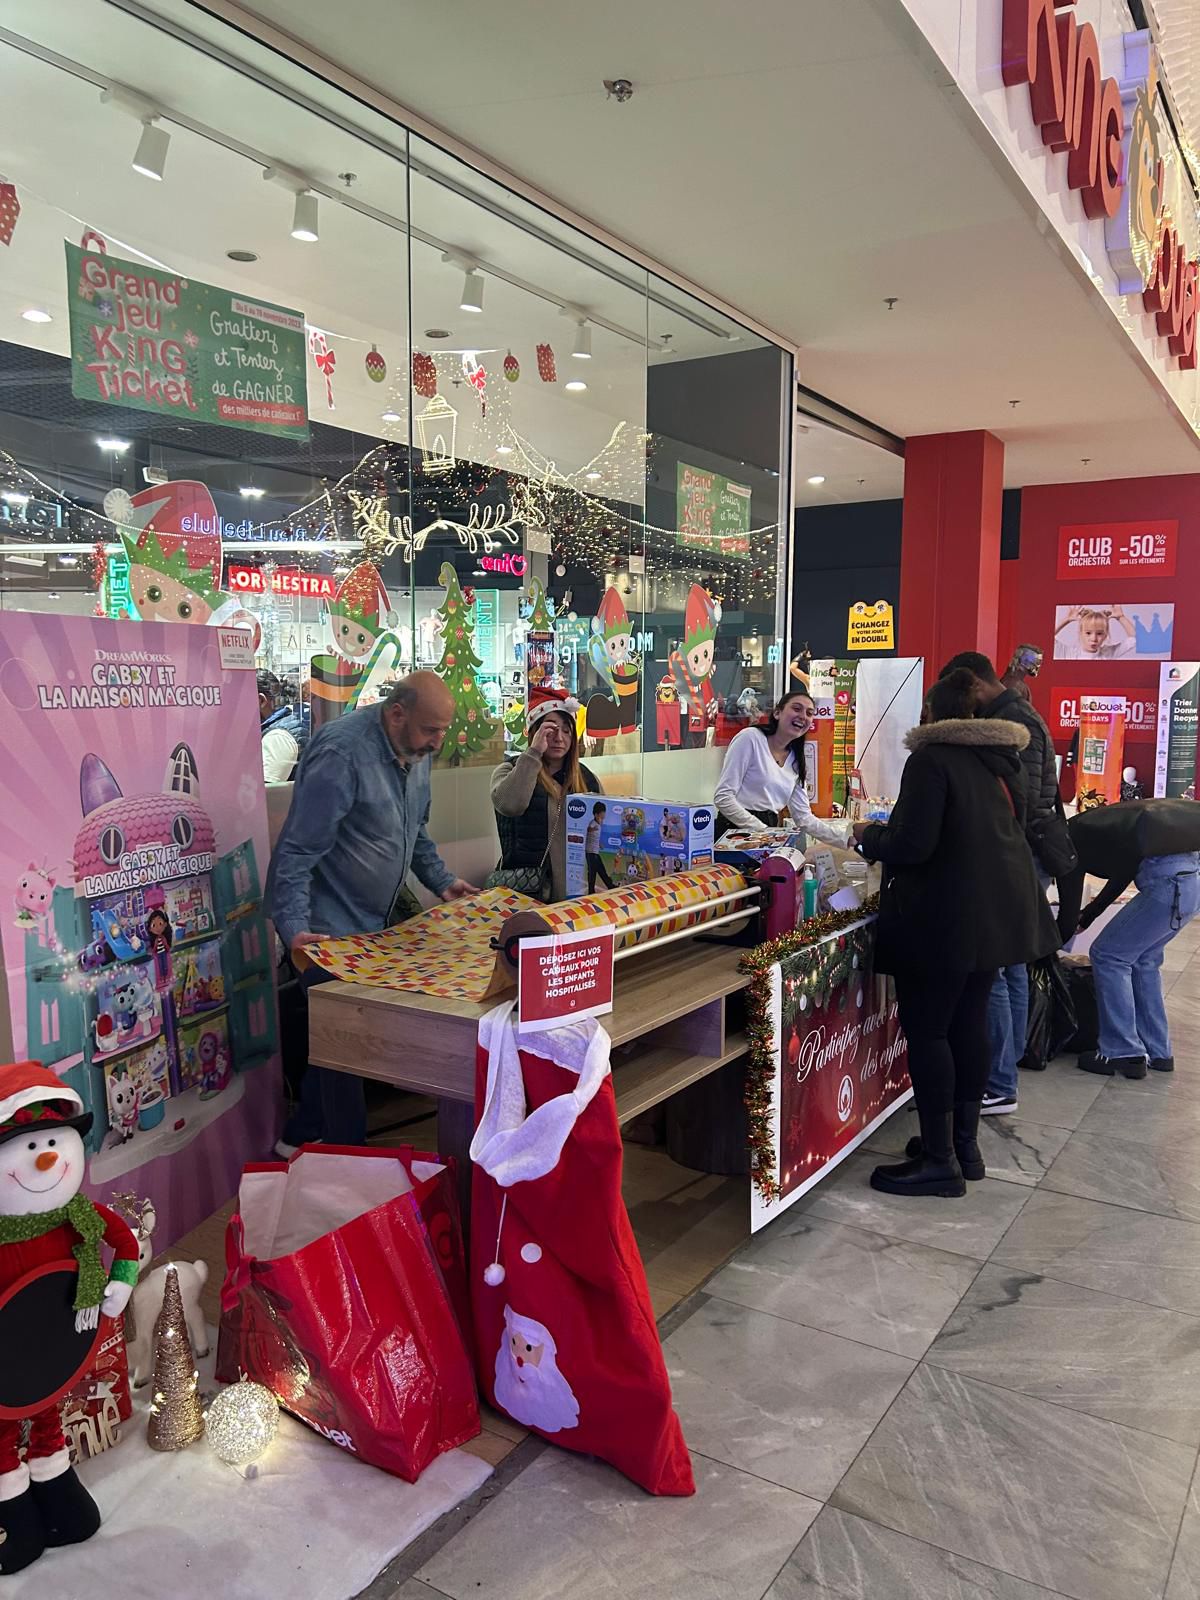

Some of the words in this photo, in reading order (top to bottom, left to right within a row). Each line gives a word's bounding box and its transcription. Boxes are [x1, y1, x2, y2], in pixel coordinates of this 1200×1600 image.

[81, 256, 181, 306] Grand
[114, 294, 162, 334] jeu
[214, 348, 231, 366] et
[84, 363, 198, 412] Ticket
[212, 380, 230, 397] de
[233, 380, 295, 404] GAGNER
[1068, 537, 1112, 557] CLUB
[1068, 556, 1111, 567] ORCHESTRA
[221, 634, 250, 650] NETFLIX
[861, 635, 888, 643] DOUBLE
[92, 664, 151, 687] GABBY
[156, 665, 175, 685] ET
[38, 685, 68, 709] LA
[70, 685, 145, 709] MAISON
[148, 685, 221, 708] MAGIQUE
[1093, 701, 1123, 712] Jouet
[568, 804, 586, 814] vtech
[693, 814, 710, 824] vtech
[121, 847, 163, 872] GABBY
[165, 846, 180, 862] ET
[86, 876, 106, 896] LA
[107, 864, 158, 891] MAISON
[158, 853, 212, 877] MAGIQUE
[539, 951, 576, 965] DÉPOSEZ
[577, 949, 586, 958] ICI
[587, 946, 601, 956] VOS
[542, 963, 580, 976] CADEAUX
[580, 957, 599, 969] POUR
[545, 978, 596, 998] HOSPITALISÉS
[548, 977, 564, 987] LES
[564, 969, 595, 984] ENFANTS
[797, 1025, 862, 1082] Participez
[860, 1047, 879, 1083] des
[880, 1026, 908, 1078] enfan
